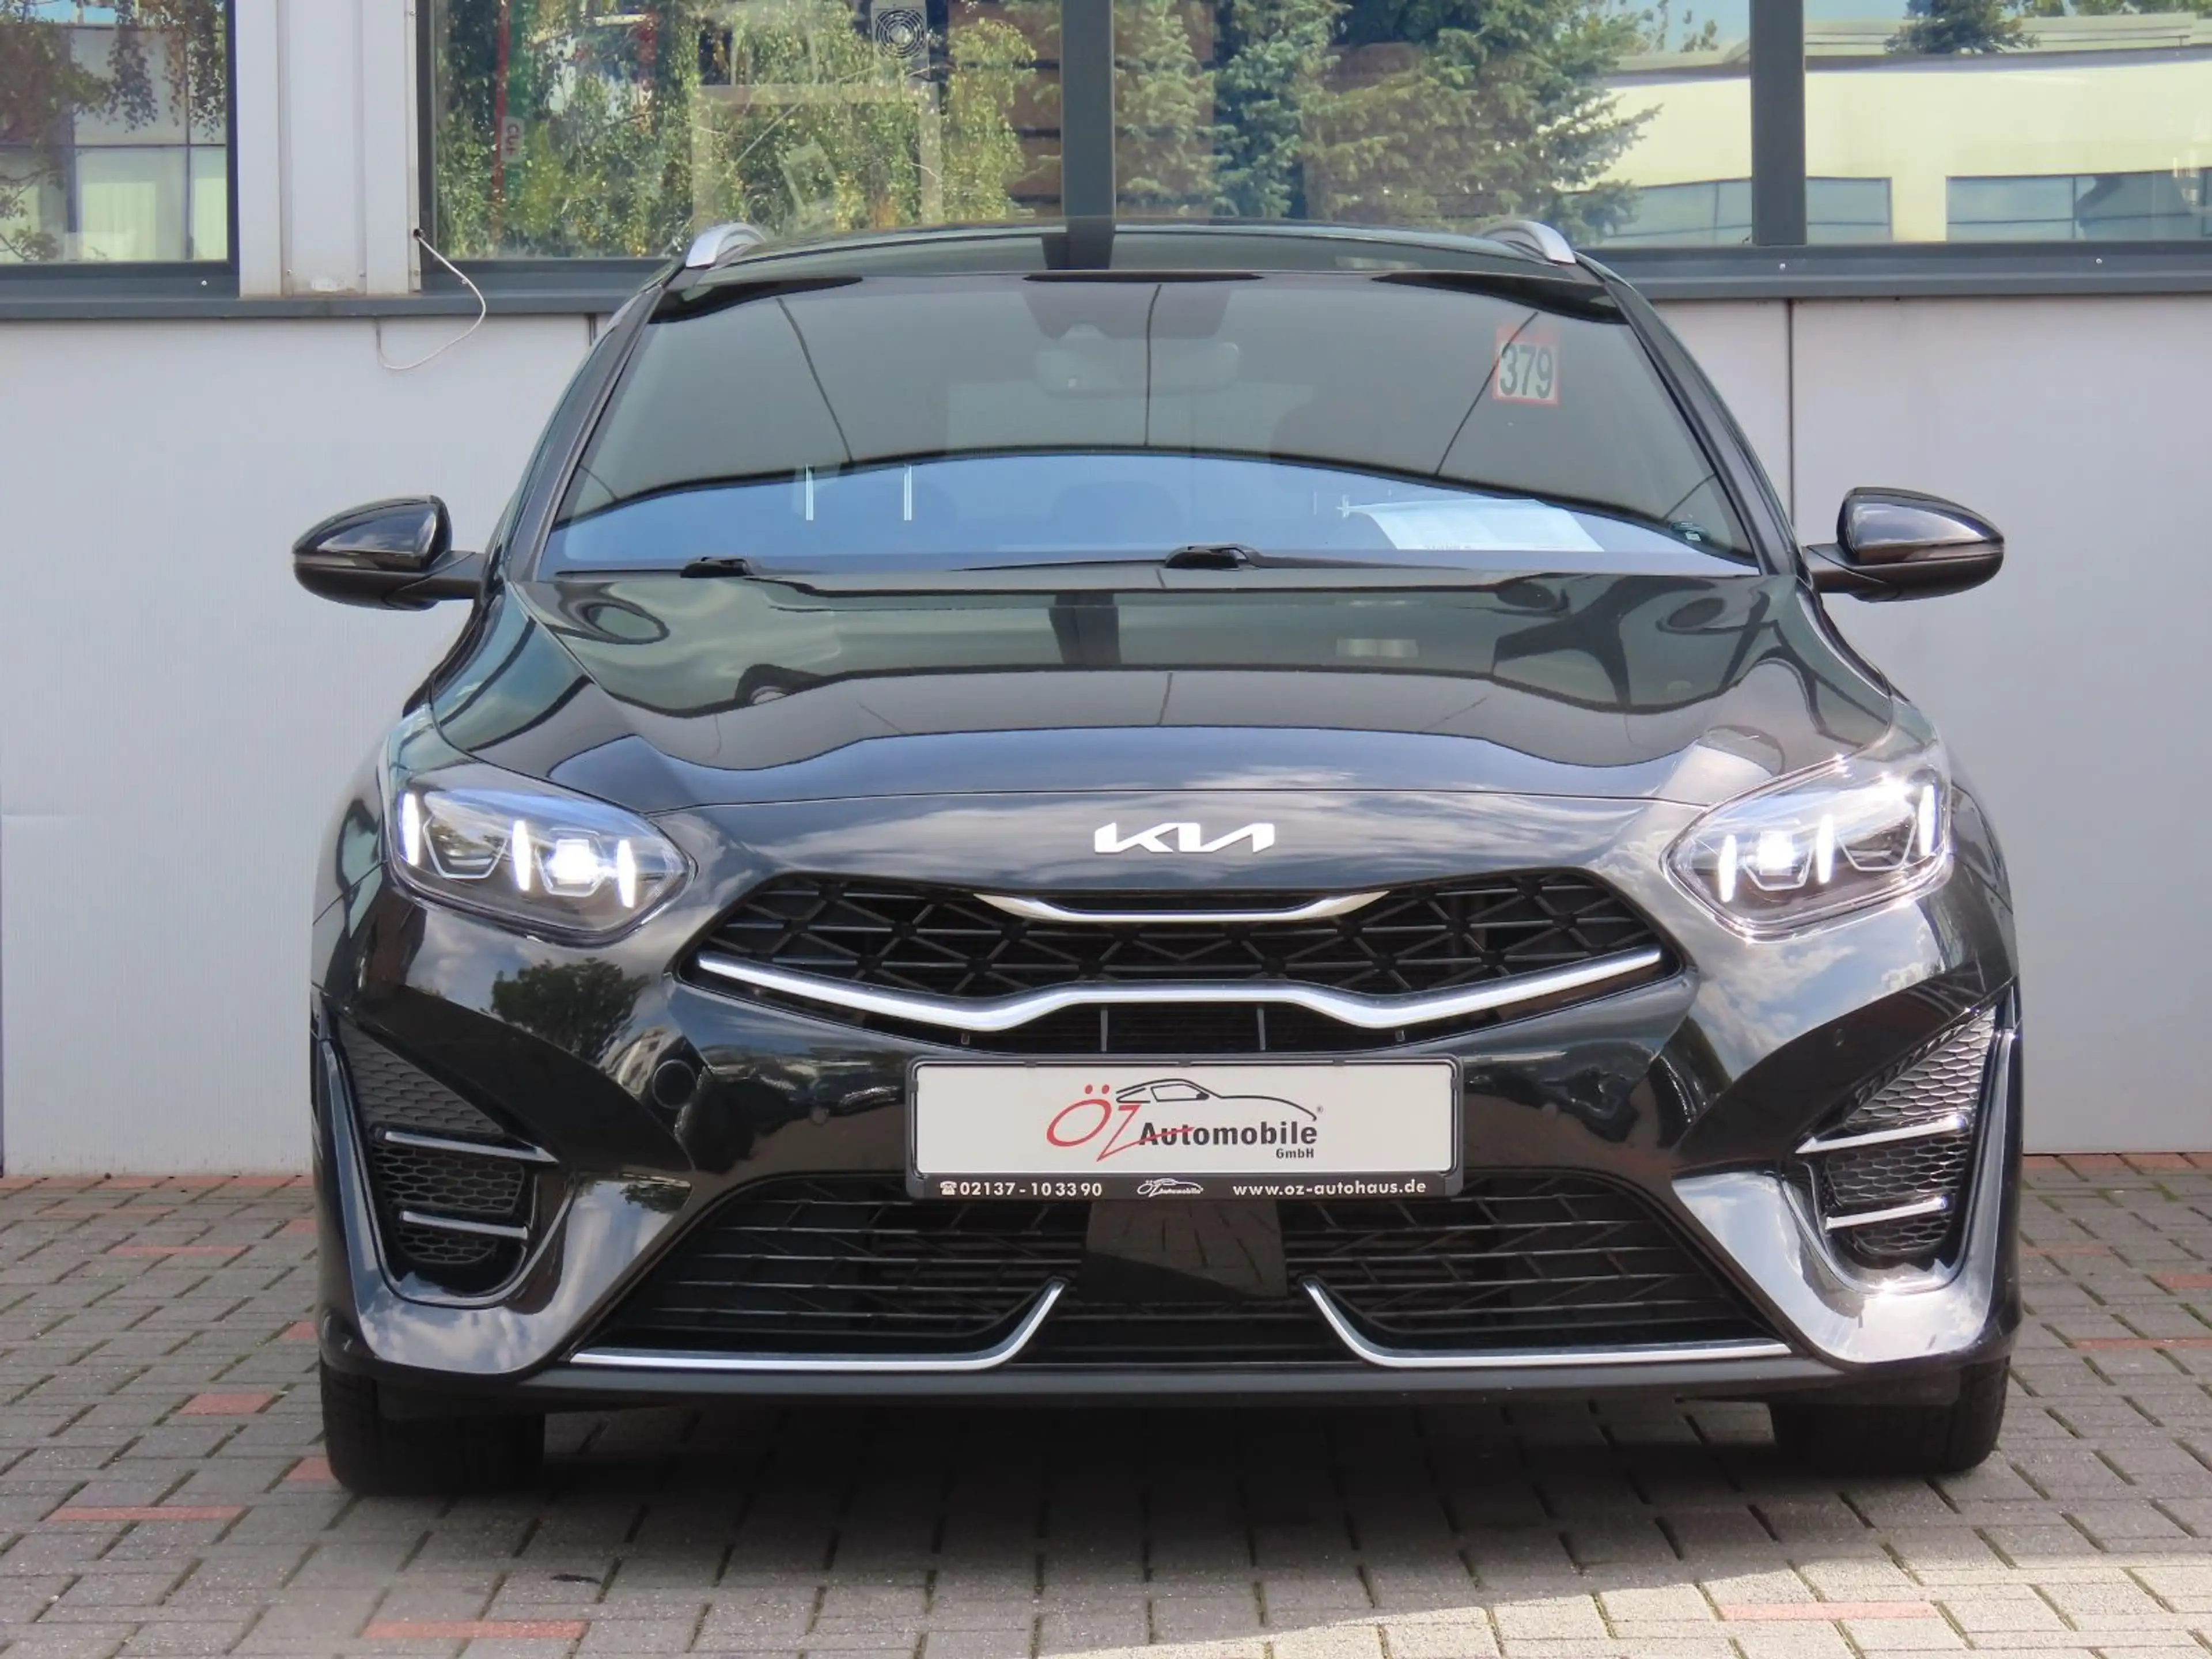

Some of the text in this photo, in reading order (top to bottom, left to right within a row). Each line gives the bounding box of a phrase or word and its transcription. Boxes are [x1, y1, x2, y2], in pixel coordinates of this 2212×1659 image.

[1500, 343, 1552, 398] 379
[1094, 822, 1275, 853] KIA
[1139, 1121, 1317, 1145] Automobile
[1275, 1148, 1314, 1158] GmbH
[1233, 1179, 1426, 1196] www.oz-autohaus.de
